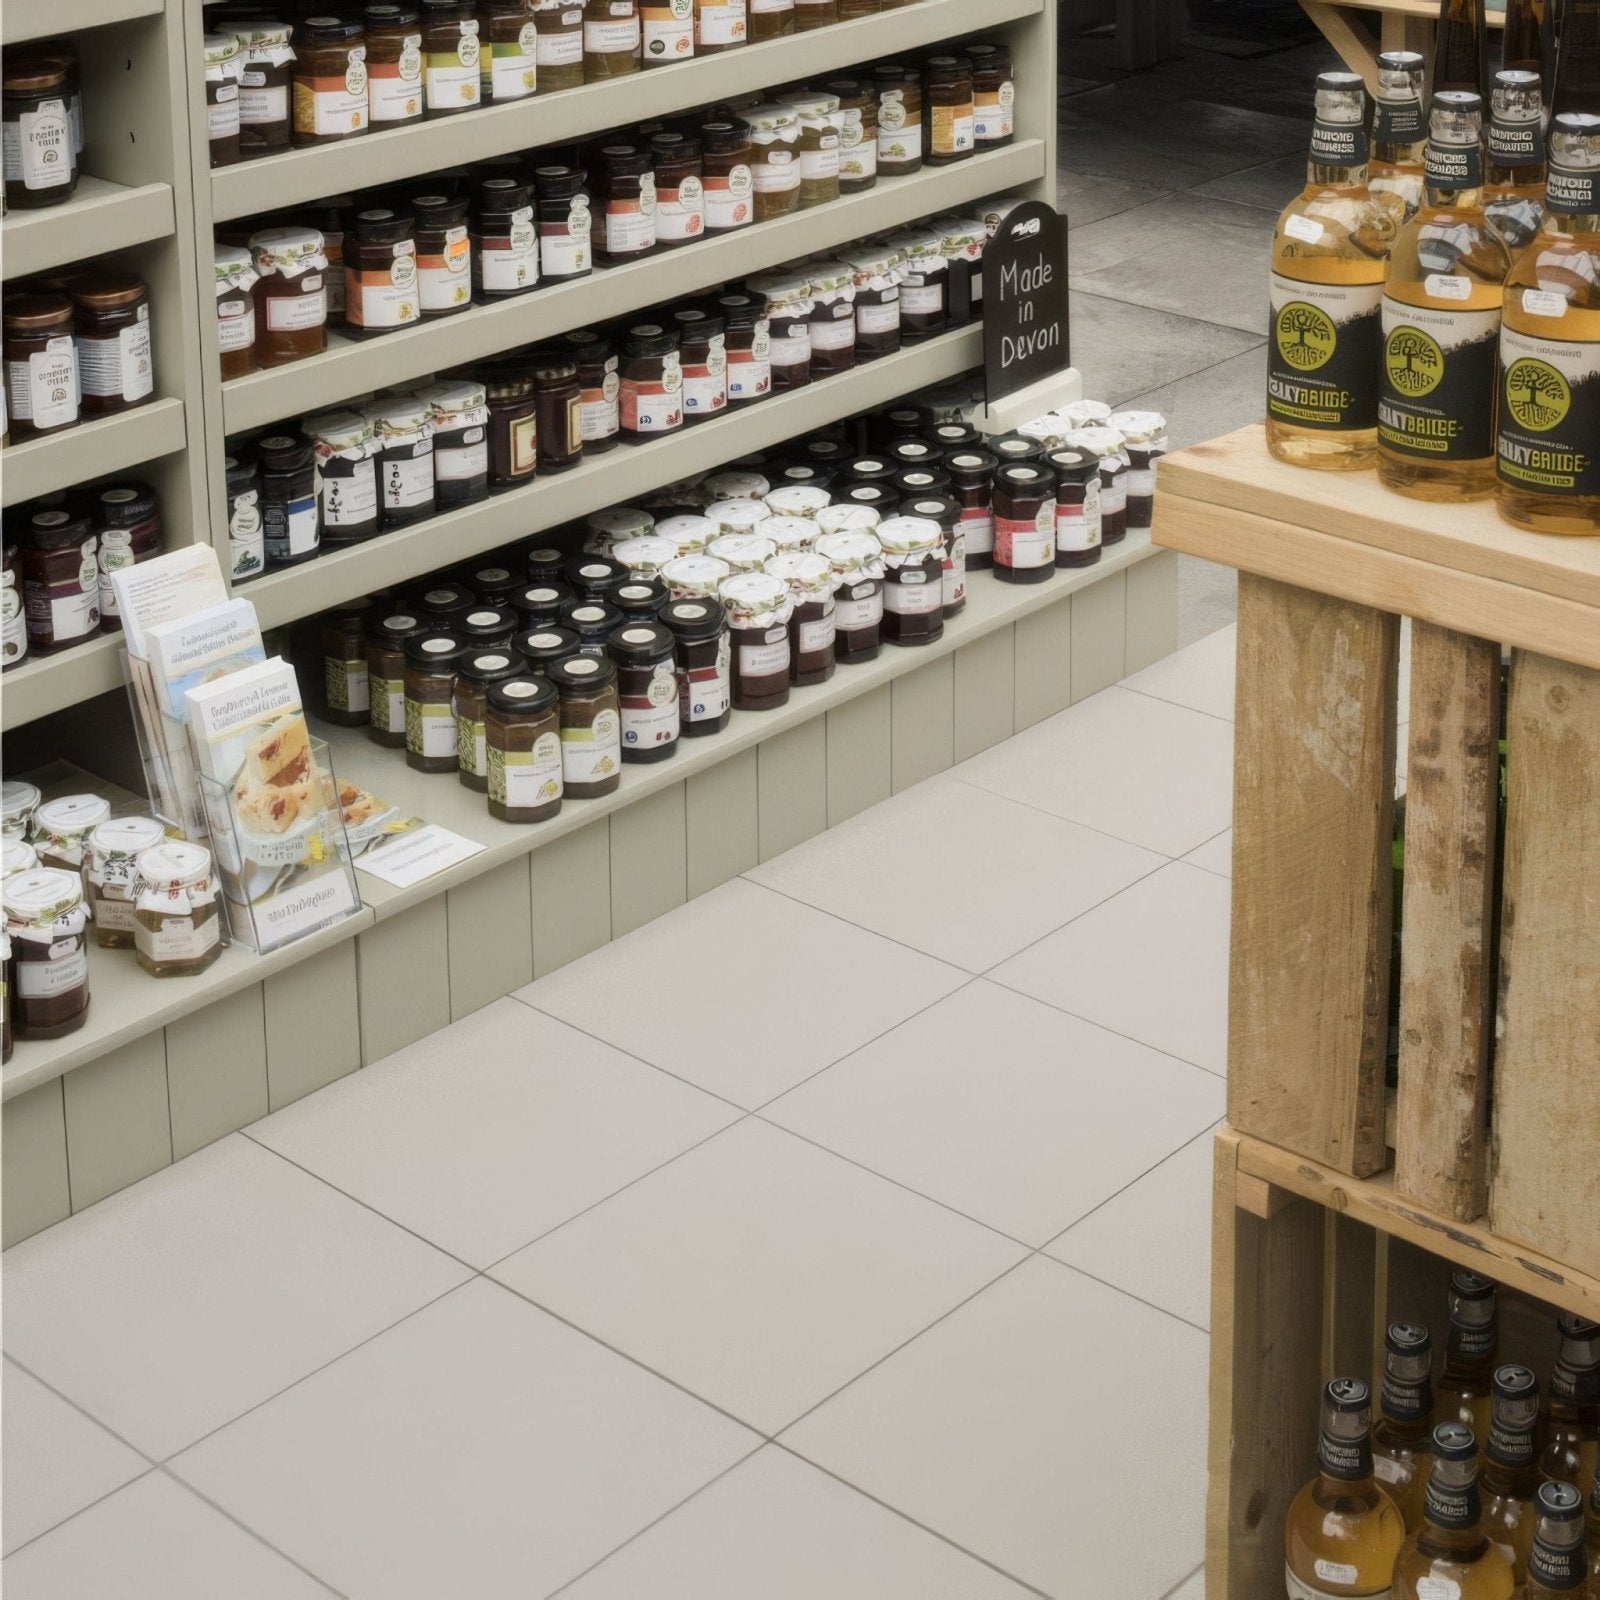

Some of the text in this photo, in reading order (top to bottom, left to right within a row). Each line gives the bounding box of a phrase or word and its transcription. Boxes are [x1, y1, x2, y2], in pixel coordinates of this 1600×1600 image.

[1000, 252, 1053, 301] Made
[1018, 300, 1034, 324] in
[1001, 321, 1059, 368] Devon
